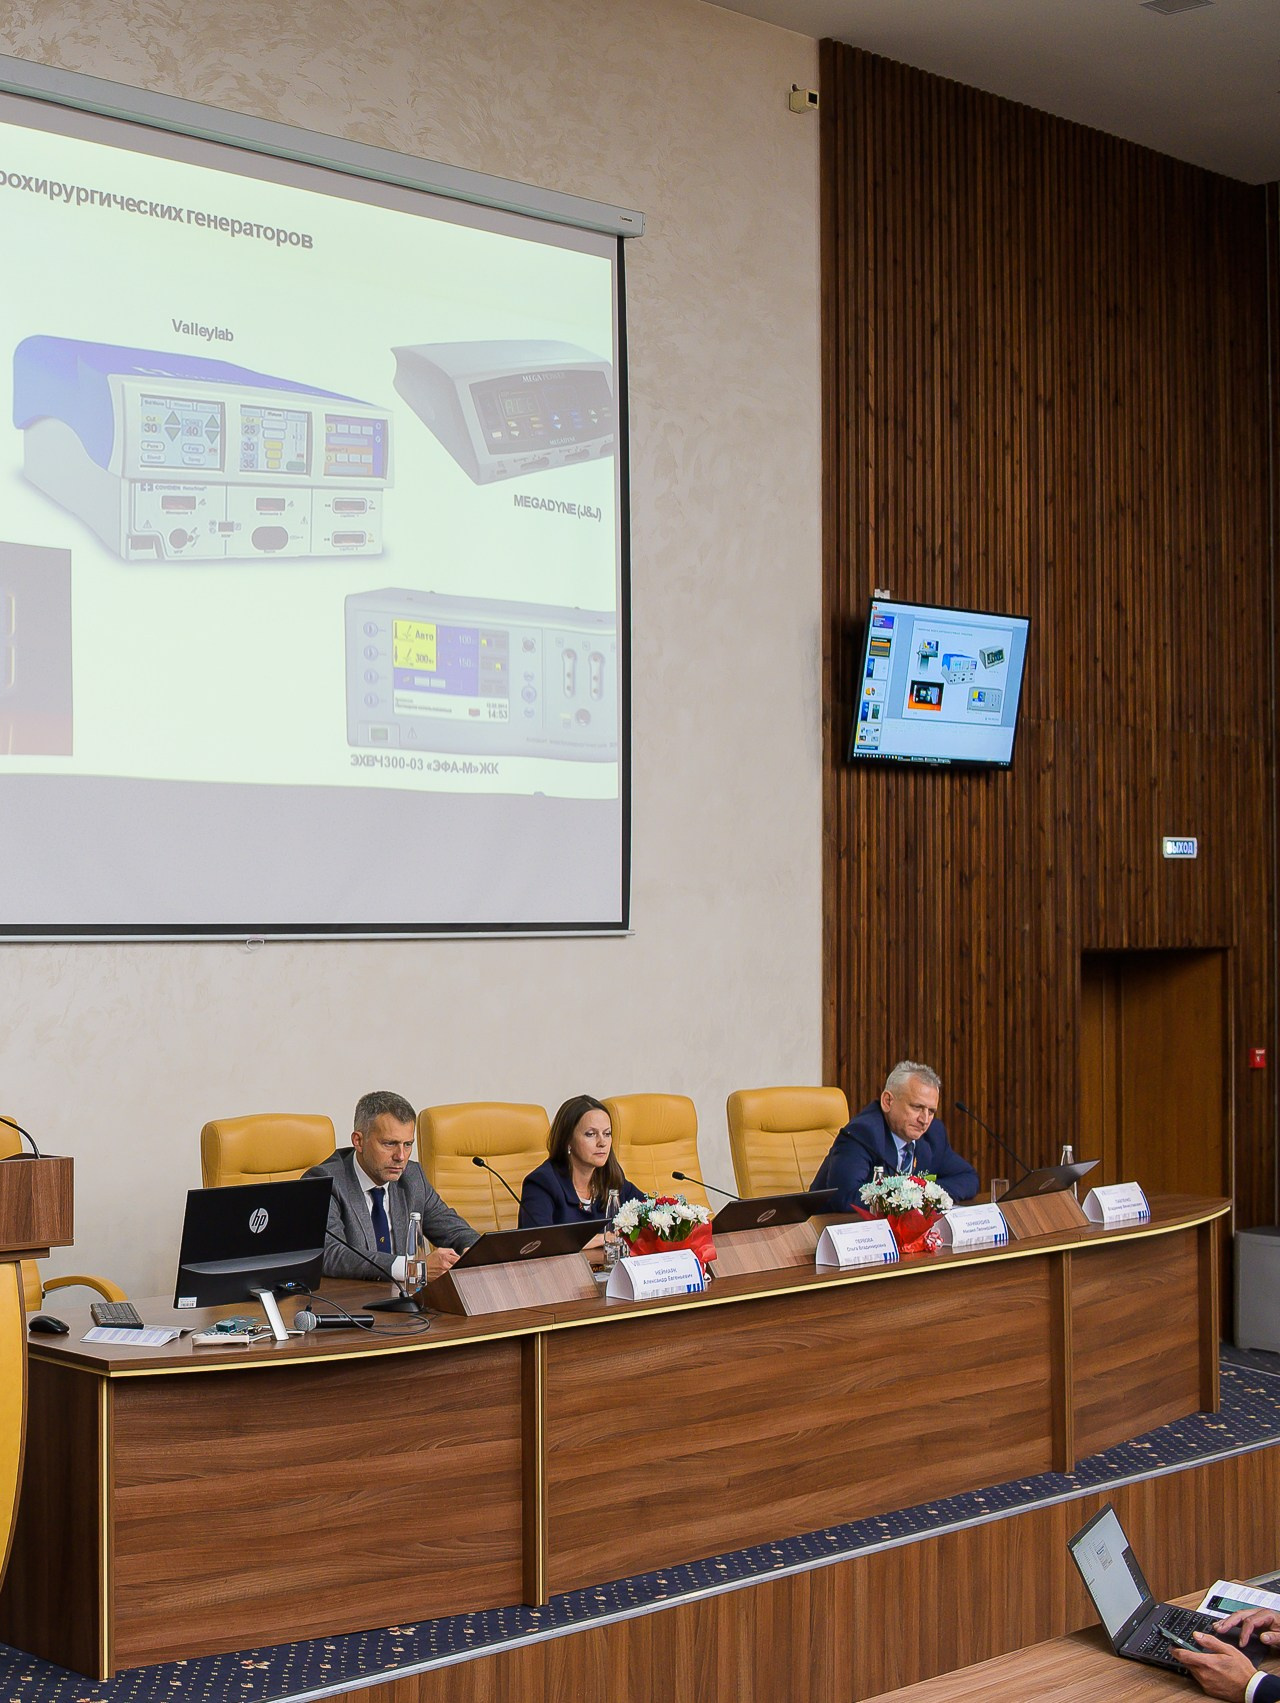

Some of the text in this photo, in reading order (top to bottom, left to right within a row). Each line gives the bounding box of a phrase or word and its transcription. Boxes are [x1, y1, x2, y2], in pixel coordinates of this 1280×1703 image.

[186, 209, 314, 249] генераторов
[171, 318, 234, 342] Valleylab
[143, 423, 158, 433] 30
[186, 426, 199, 436] 40
[243, 424, 256, 434] 25
[513, 494, 602, 523] MEGADYNE (J&J)
[1166, 841, 1193, 855] ВЫХОД
[249, 1207, 269, 1234] hp
